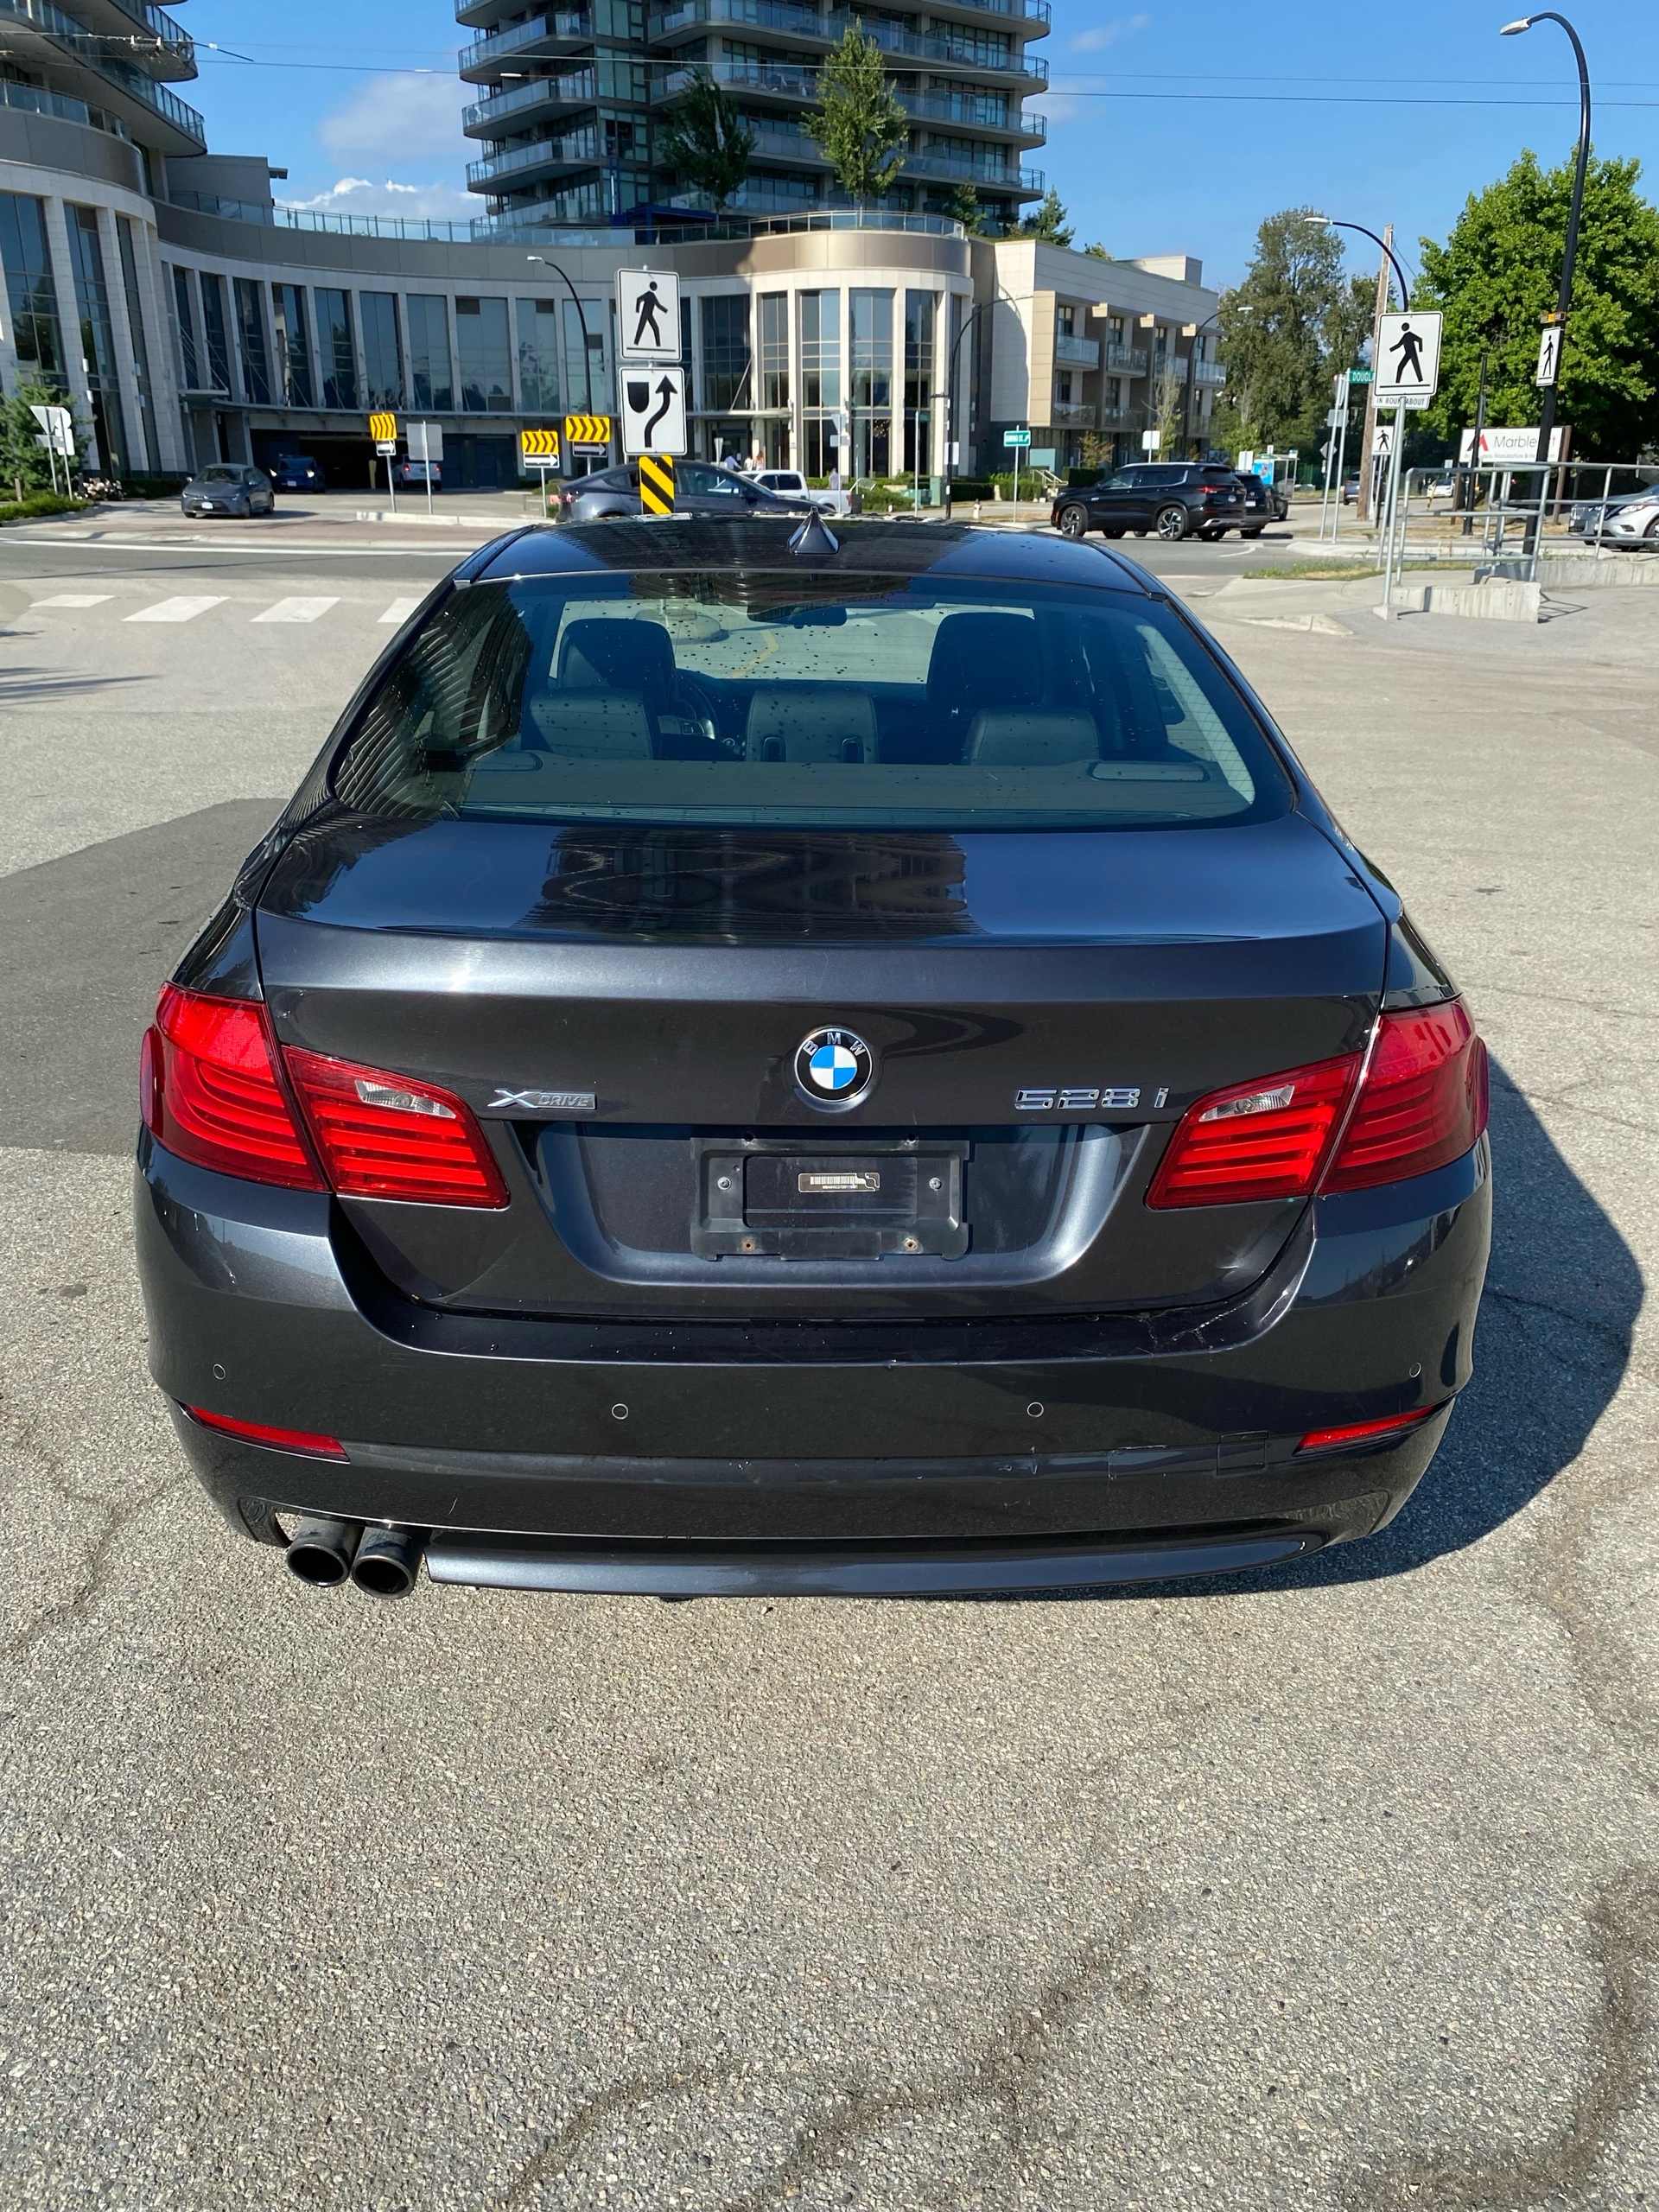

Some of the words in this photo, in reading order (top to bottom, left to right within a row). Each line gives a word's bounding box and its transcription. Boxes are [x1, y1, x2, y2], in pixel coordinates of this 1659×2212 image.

[1352, 372, 1375, 382] DOUGLA
[1385, 397, 1425, 406] ROUNABOUT
[803, 1032, 867, 1056] BMW
